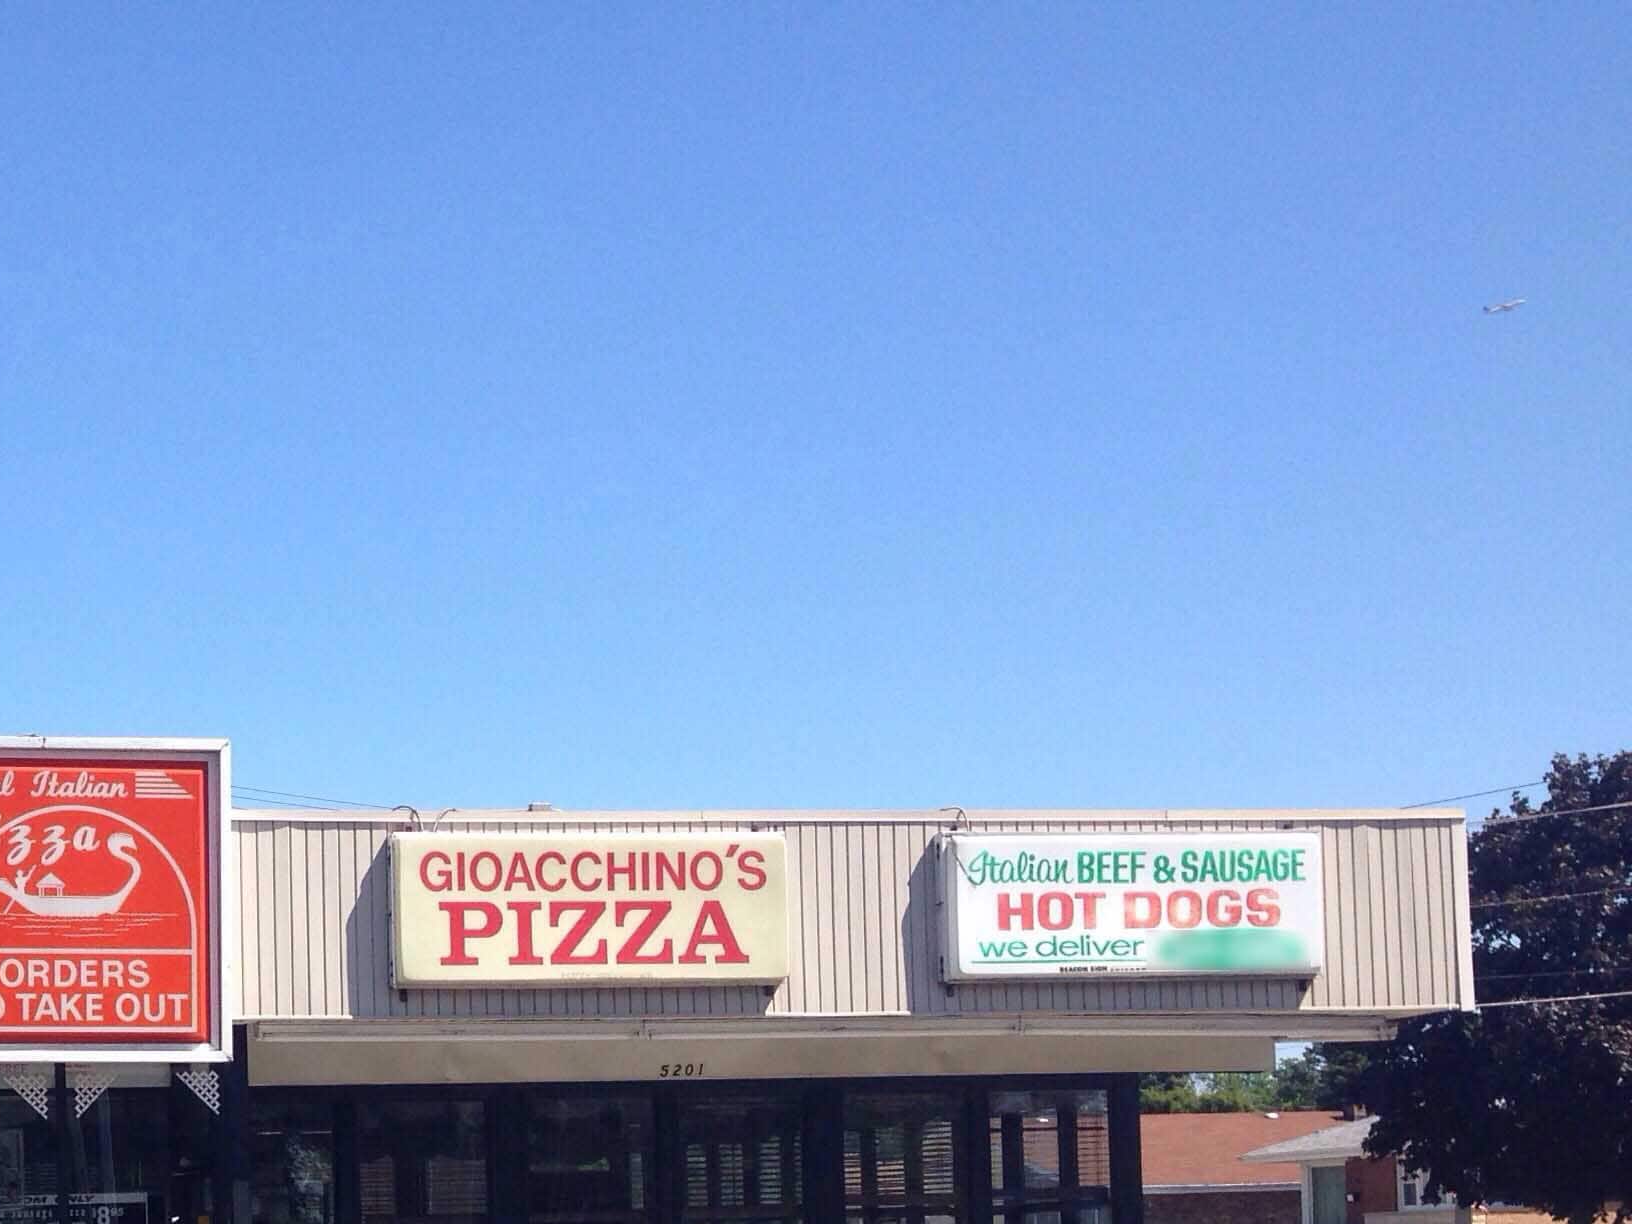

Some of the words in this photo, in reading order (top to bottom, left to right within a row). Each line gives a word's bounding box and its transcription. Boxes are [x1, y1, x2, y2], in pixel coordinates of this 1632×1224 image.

[30, 770, 129, 798] Italian
[419, 844, 768, 892] GIOACCHINO'S
[968, 849, 1076, 887] Italian
[1076, 851, 1147, 886] BEEF
[1153, 855, 1175, 883] &
[1179, 848, 1307, 885] SAUSAGE
[996, 891, 1106, 931] HOT
[1121, 888, 1282, 929] DOGS
[439, 899, 750, 966] PIZZA
[979, 939, 1027, 957] we
[1035, 935, 1145, 957] deliver
[0, 958, 150, 988] ORDERS
[15, 993, 104, 1021] TAKE
[115, 993, 188, 1022] OUT
[659, 1063, 705, 1078] 5201
